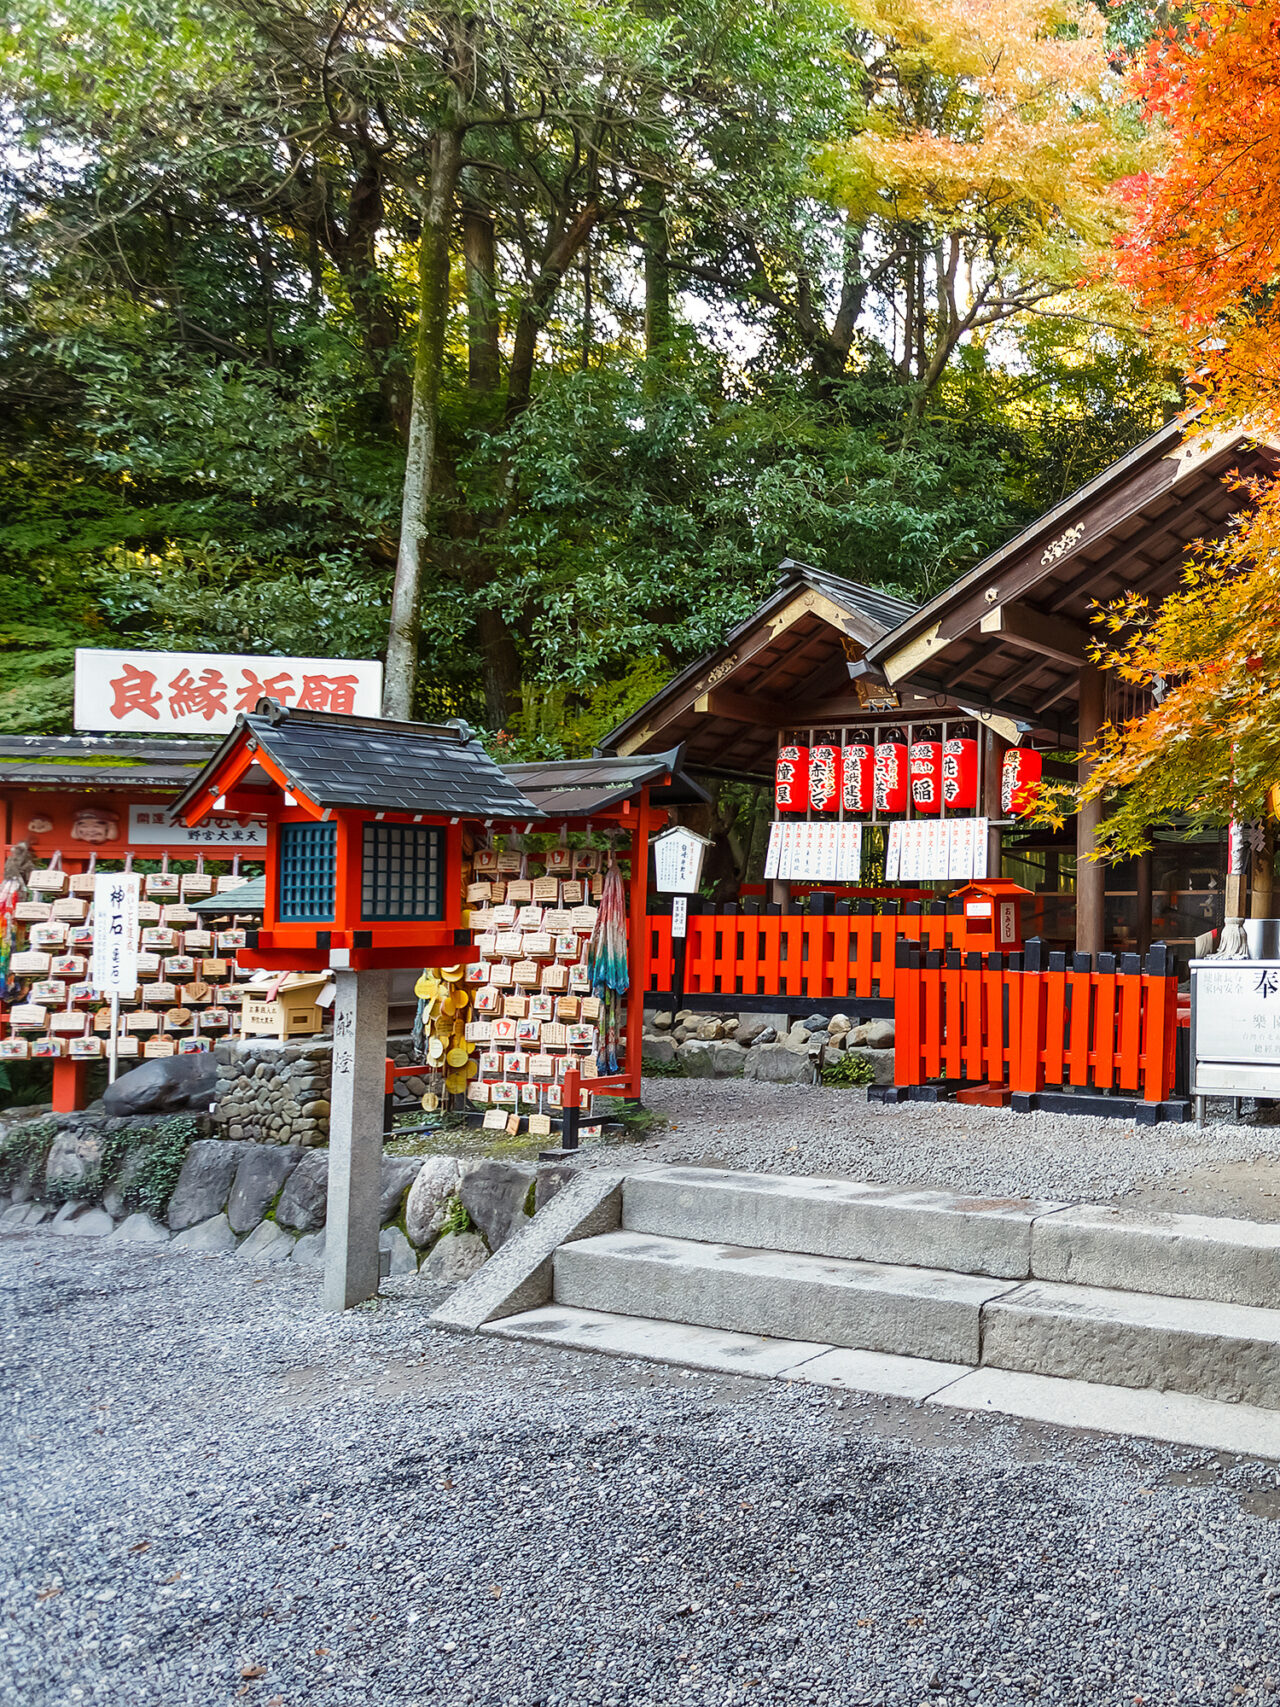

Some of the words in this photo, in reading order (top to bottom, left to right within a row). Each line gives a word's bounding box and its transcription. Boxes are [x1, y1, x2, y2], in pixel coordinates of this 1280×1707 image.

[109, 663, 359, 720] 良縁祈願
[810, 761, 826, 808] 赤マンマ
[914, 780, 932, 801] 稲
